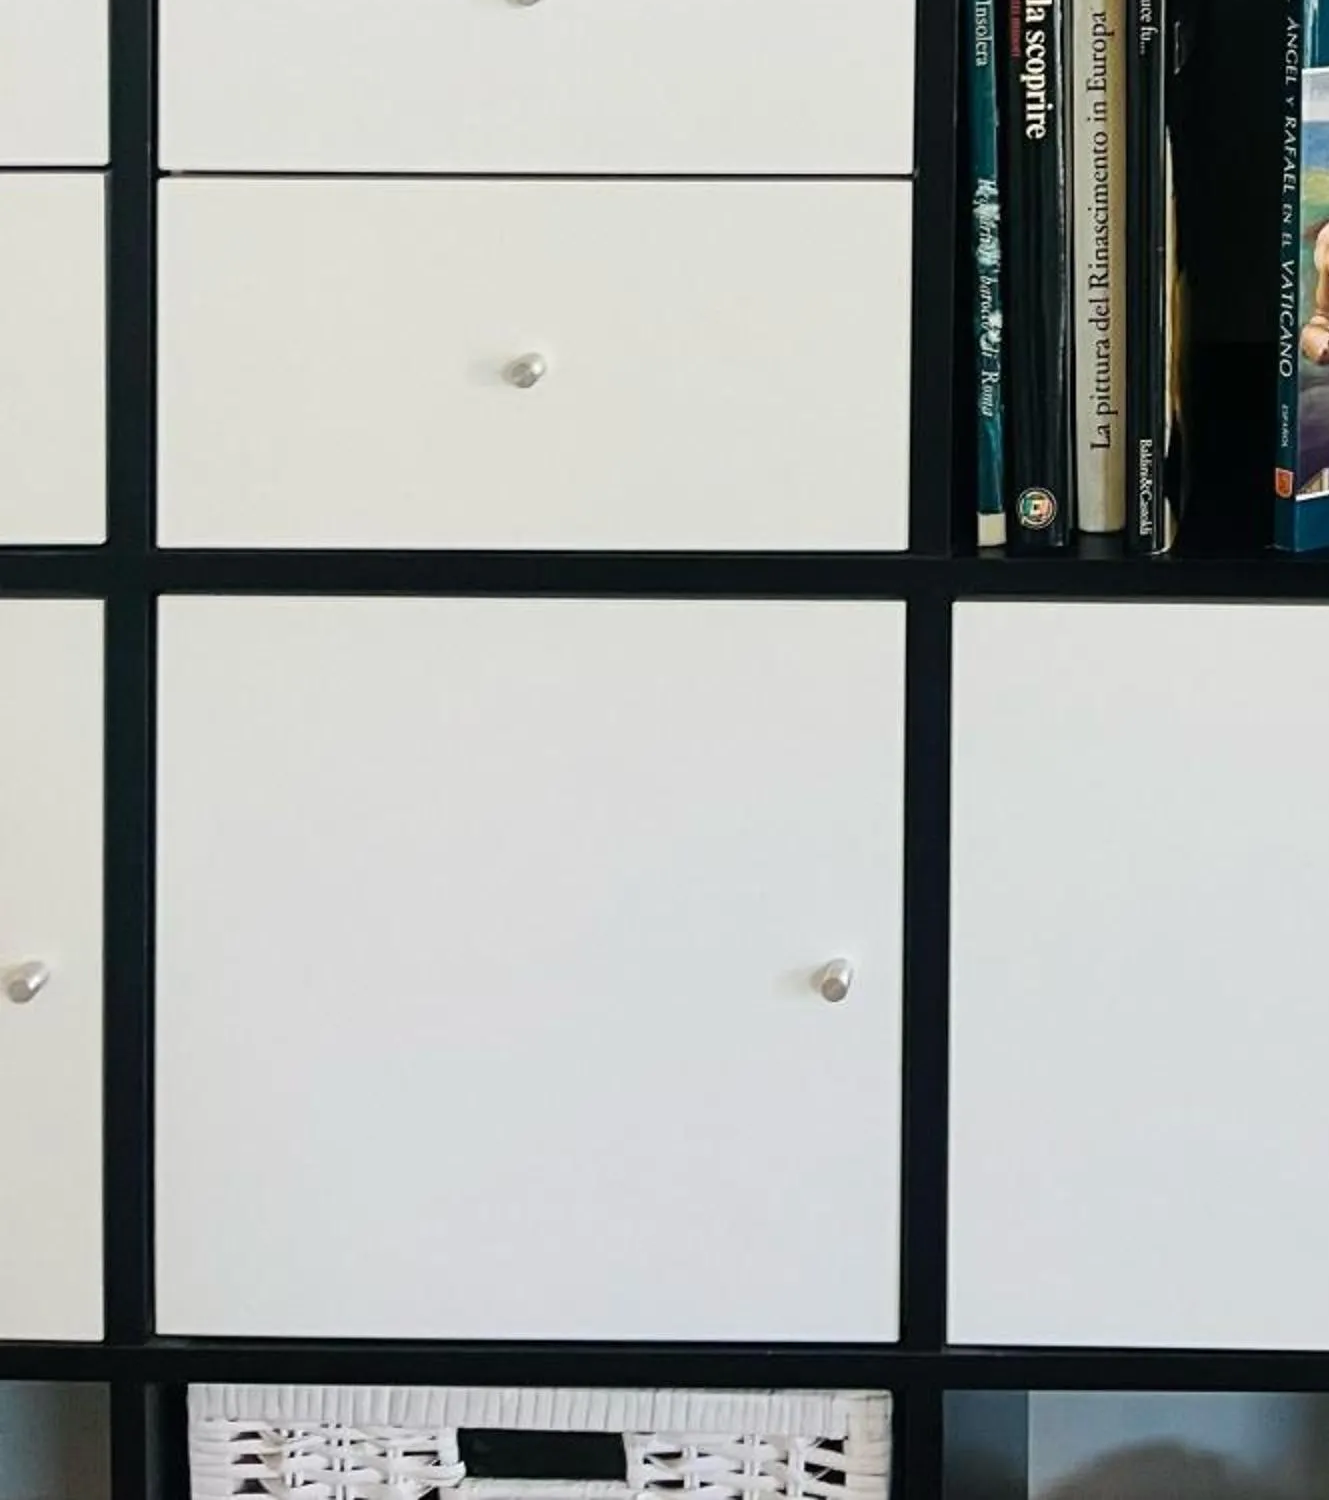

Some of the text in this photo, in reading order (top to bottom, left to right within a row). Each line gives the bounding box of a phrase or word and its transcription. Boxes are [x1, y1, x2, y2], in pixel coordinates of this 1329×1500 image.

[975, 0, 993, 68] Insolera
[1020, 30, 1054, 141] scoprire
[1283, 115, 1297, 194] RAFAEL
[1086, 11, 1119, 451] La pittura del Rinascimento in Europa
[1282, 232, 1293, 248] EL
[1283, 203, 1293, 225] EN
[1279, 260, 1295, 378] VATICANO
[981, 369, 1000, 418] Roma
